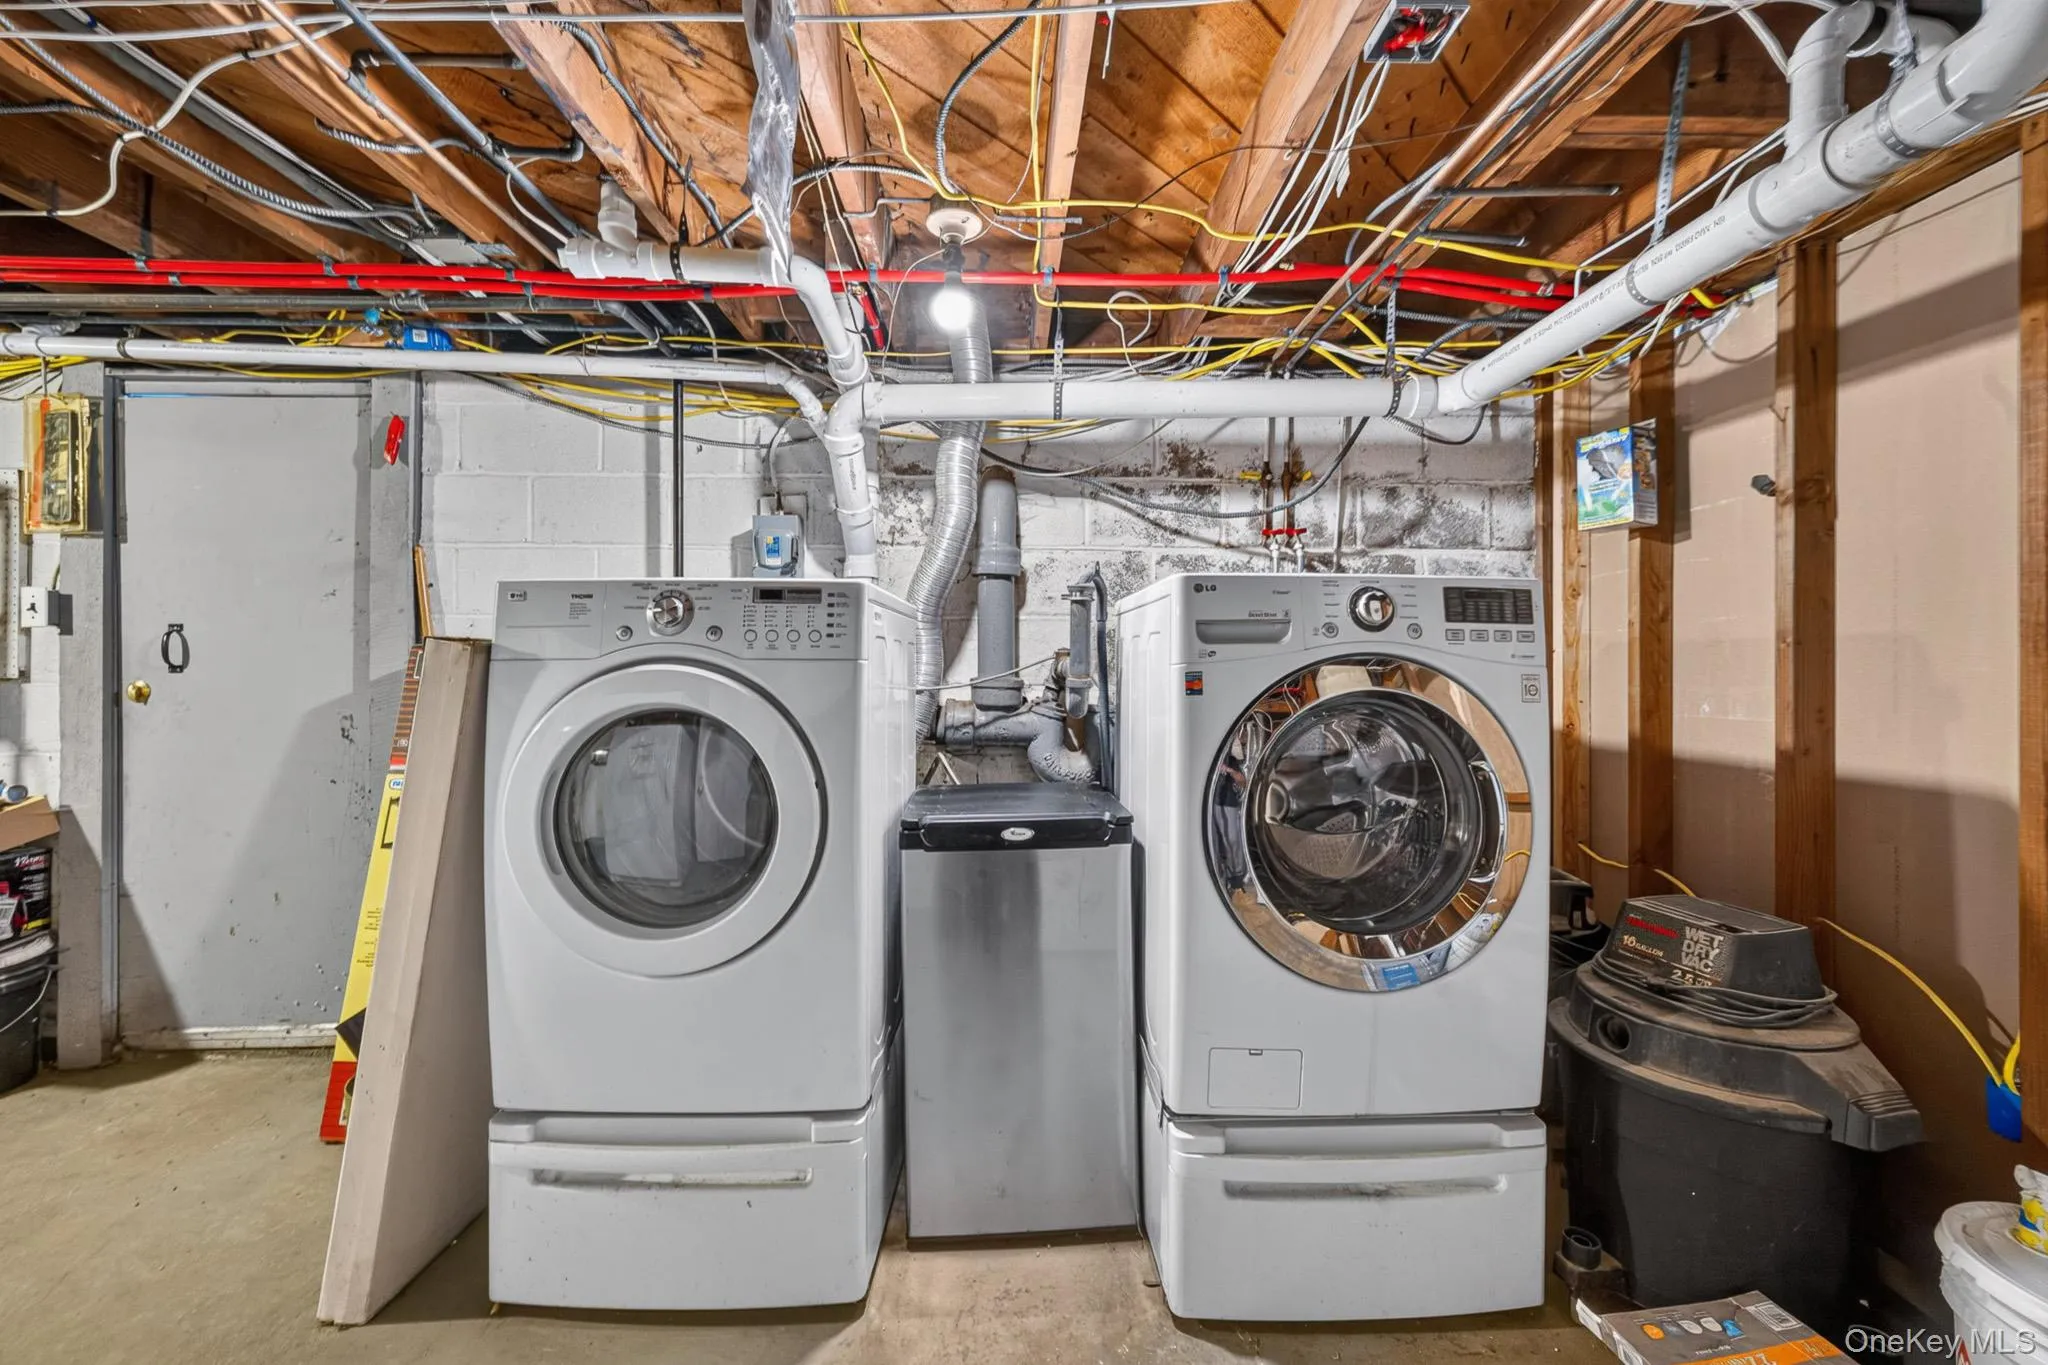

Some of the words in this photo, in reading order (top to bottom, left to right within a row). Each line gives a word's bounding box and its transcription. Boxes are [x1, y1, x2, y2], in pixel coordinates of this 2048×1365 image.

[1685, 926, 1725, 949] WET
[1682, 939, 1720, 961] DRY
[1681, 951, 1714, 974] VAC
